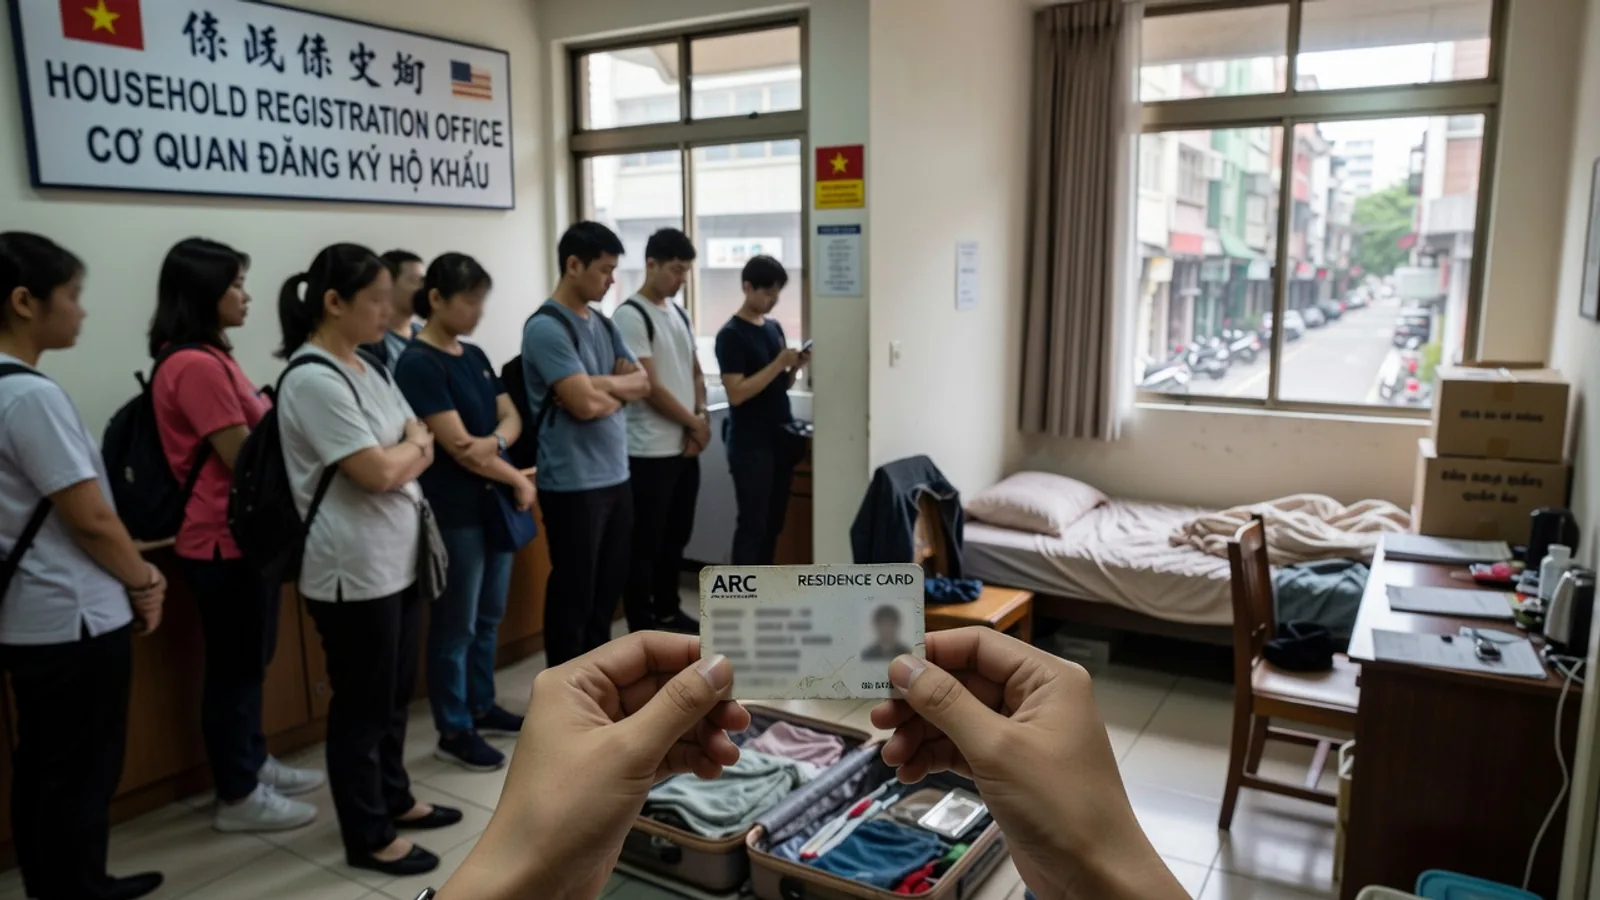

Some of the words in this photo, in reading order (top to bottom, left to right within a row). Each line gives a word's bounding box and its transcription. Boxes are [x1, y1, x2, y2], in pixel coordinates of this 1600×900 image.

[45, 59, 247, 117] HOUSEHOLD
[256, 89, 429, 139] REGISTRATION
[435, 113, 503, 147] OFFICE
[87, 126, 143, 164] CƠ
[154, 132, 248, 172] QUAN
[258, 135, 341, 178] ĐĂNG
[348, 143, 381, 182] KÝ
[389, 148, 423, 193] HỘ
[712, 575, 757, 593] ARC
[798, 573, 871, 586] RESIDENCE
[876, 573, 914, 585] CARD
